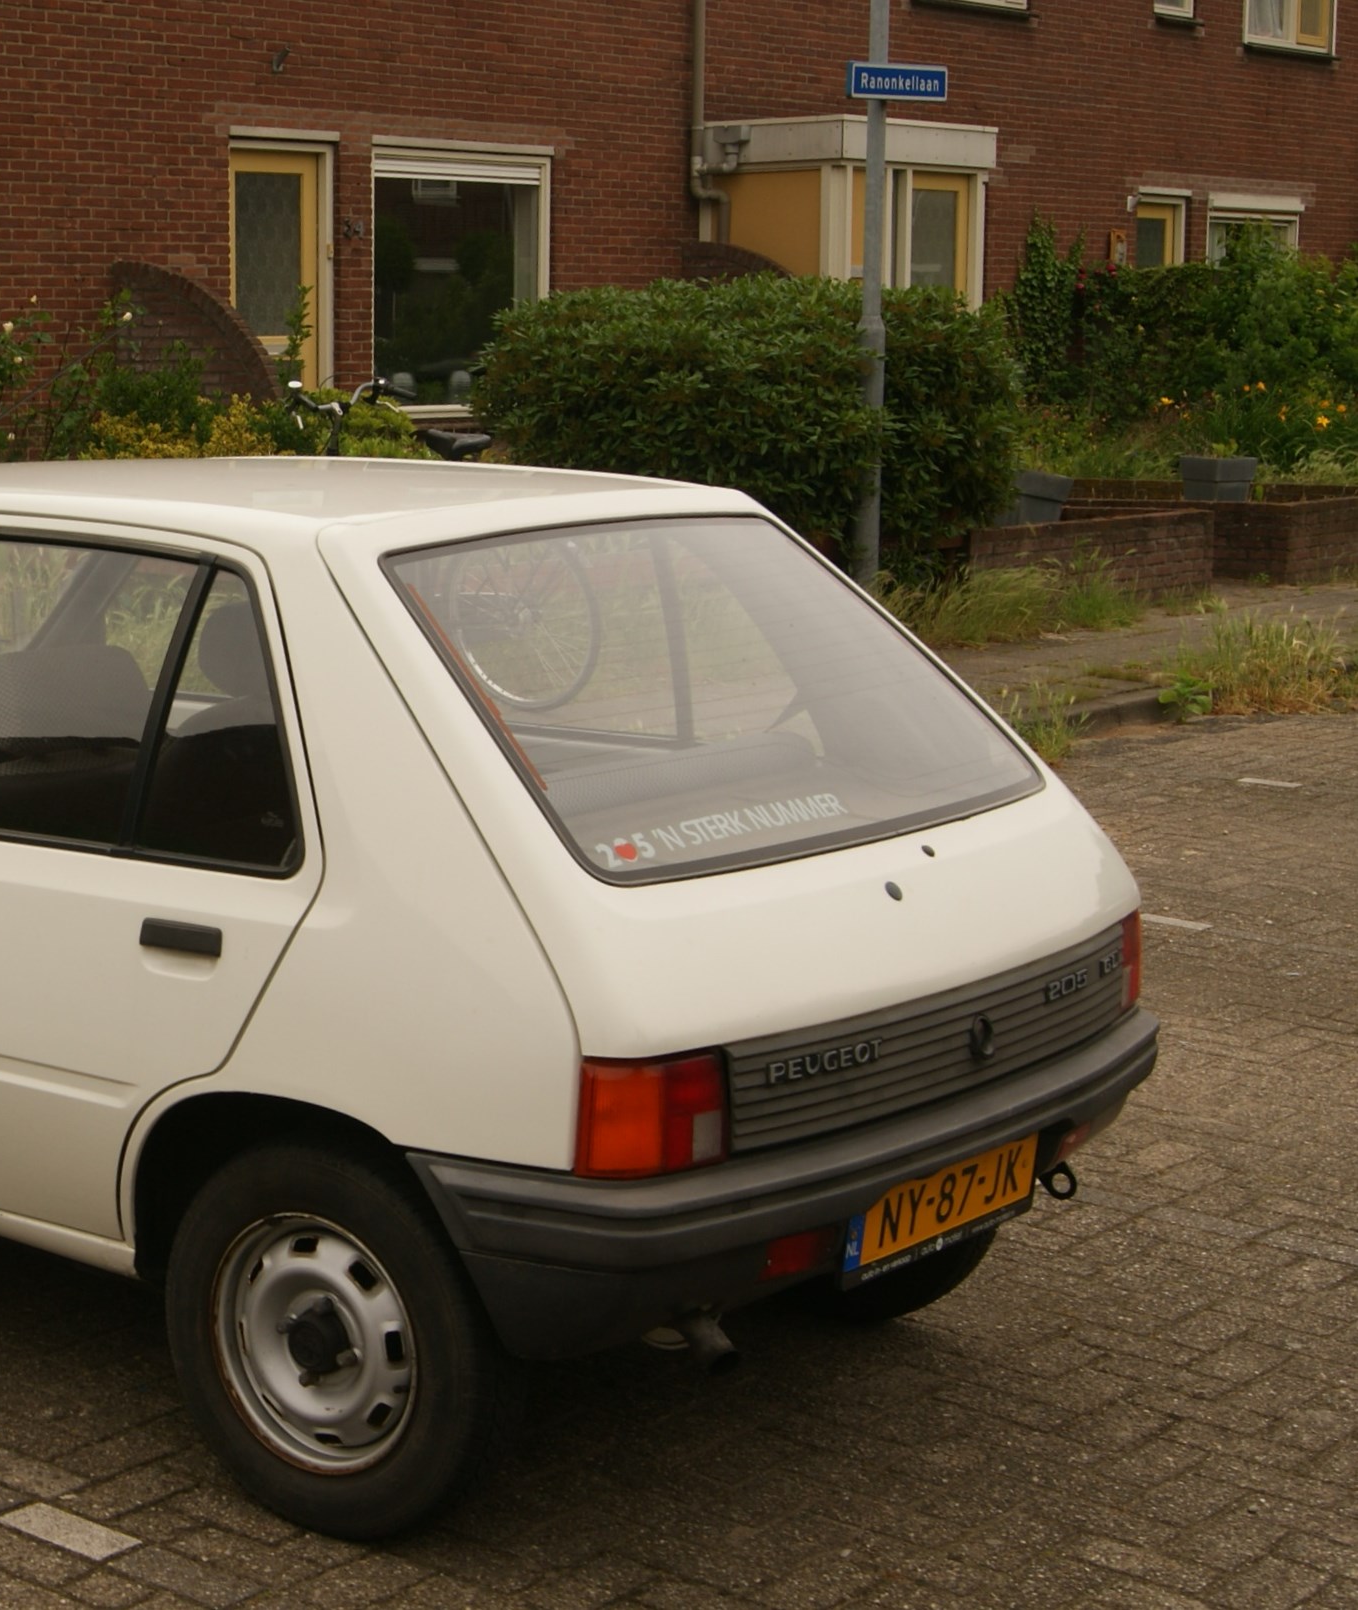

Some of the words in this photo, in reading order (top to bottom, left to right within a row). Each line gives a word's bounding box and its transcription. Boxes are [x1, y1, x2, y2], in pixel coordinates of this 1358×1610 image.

[861, 72, 940, 92] Ranonkellaan
[680, 810, 749, 845] STERK
[744, 793, 848, 831] NUMMER
[768, 1039, 883, 1083] PEUGEOT
[1048, 968, 1088, 1001] 205
[879, 1144, 1022, 1248] NY-87-JK
[844, 1240, 860, 1259] NL
